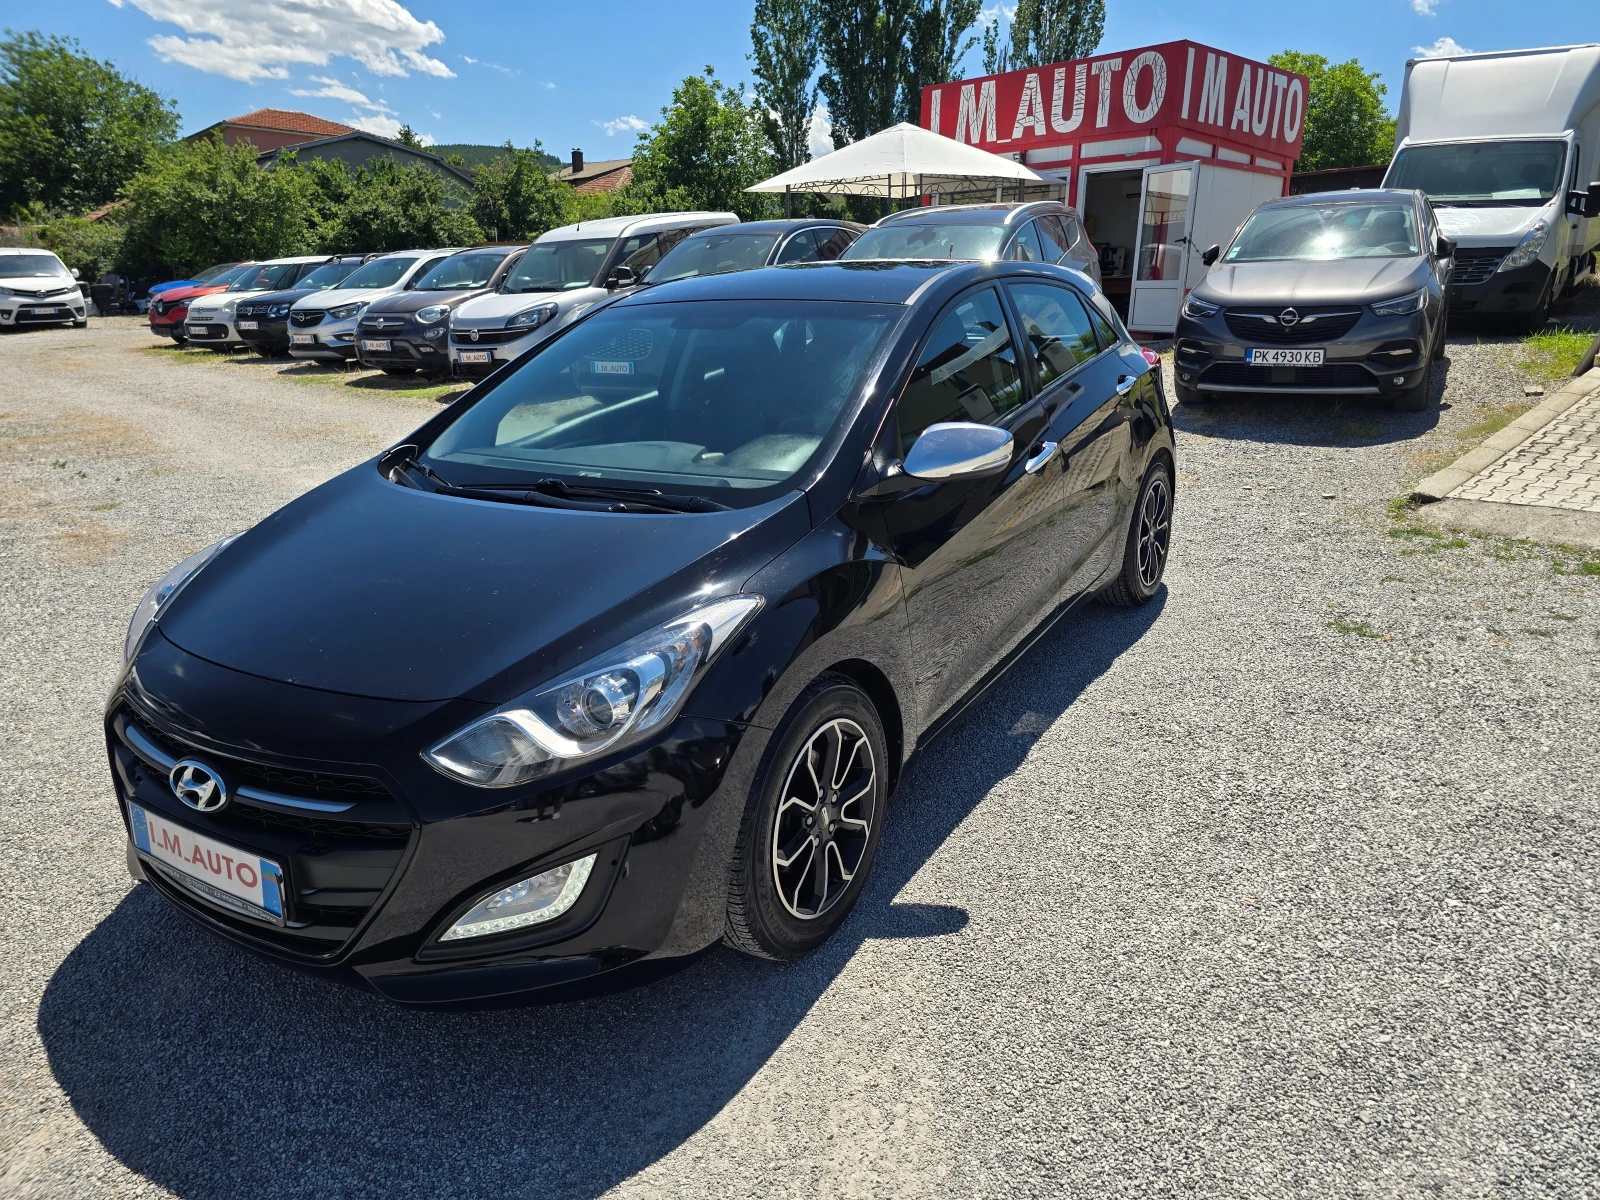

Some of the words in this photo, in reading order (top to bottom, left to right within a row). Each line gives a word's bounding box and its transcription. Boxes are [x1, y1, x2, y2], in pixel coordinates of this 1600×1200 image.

[1181, 47, 1195, 119] I
[1198, 52, 1227, 127] M
[1230, 64, 1303, 143] AUTO
[1254, 350, 1270, 362] PK
[1272, 351, 1302, 363] 4930
[1304, 351, 1321, 363] KB
